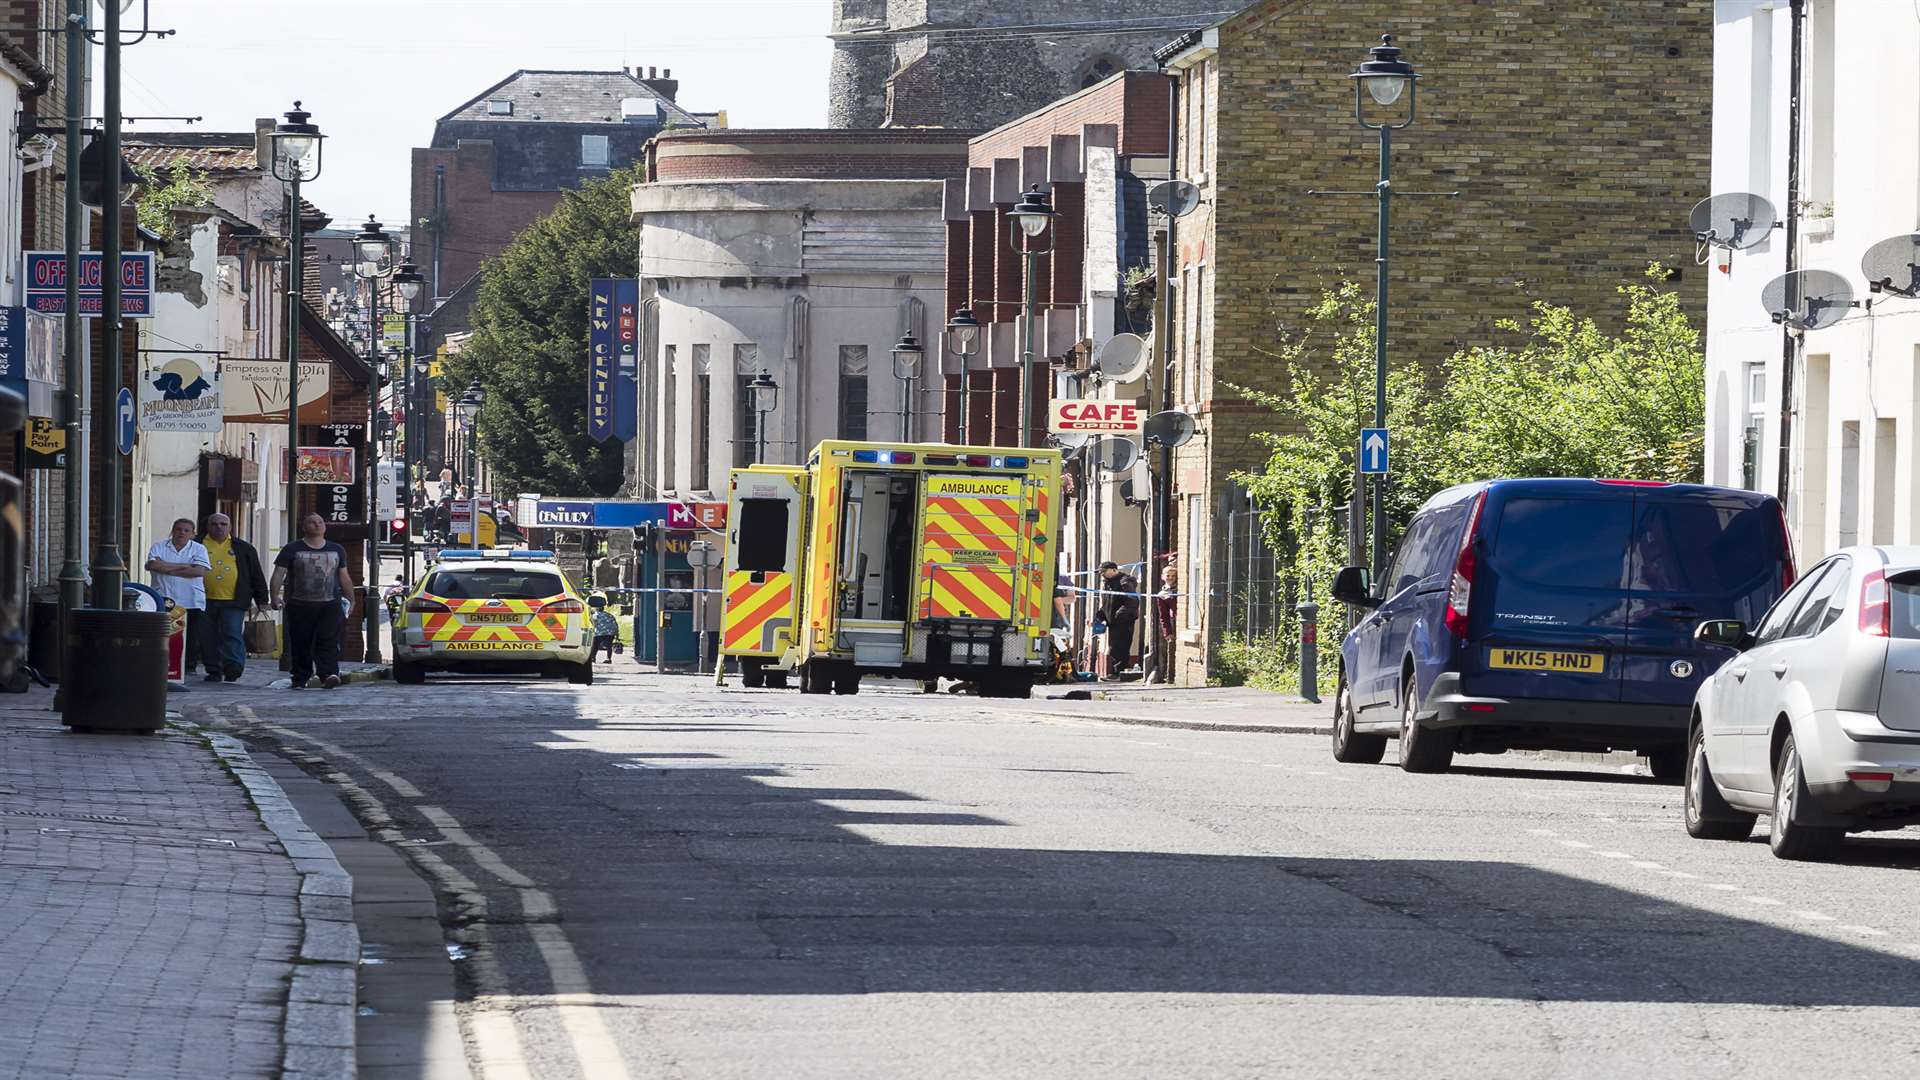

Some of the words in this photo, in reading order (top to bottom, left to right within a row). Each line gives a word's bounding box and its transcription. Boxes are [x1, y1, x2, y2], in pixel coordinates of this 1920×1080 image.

[35, 259, 66, 286] OFF
[593, 294, 611, 331] NEW
[225, 364, 270, 374] Empress
[271, 365, 283, 374] of
[594, 343, 609, 429] CENTURY
[143, 392, 219, 417] MOONBEAM
[1060, 403, 1137, 421] CAFE
[32, 433, 50, 441] Pay
[32, 440, 60, 448] Point
[940, 483, 1009, 495] AMBULANCE
[539, 510, 590, 523] CENTURY
[470, 614, 497, 623] GN57
[446, 642, 544, 650] AMBULANCE
[1503, 650, 1547, 666] WK15
[1552, 654, 1592, 669] HND
